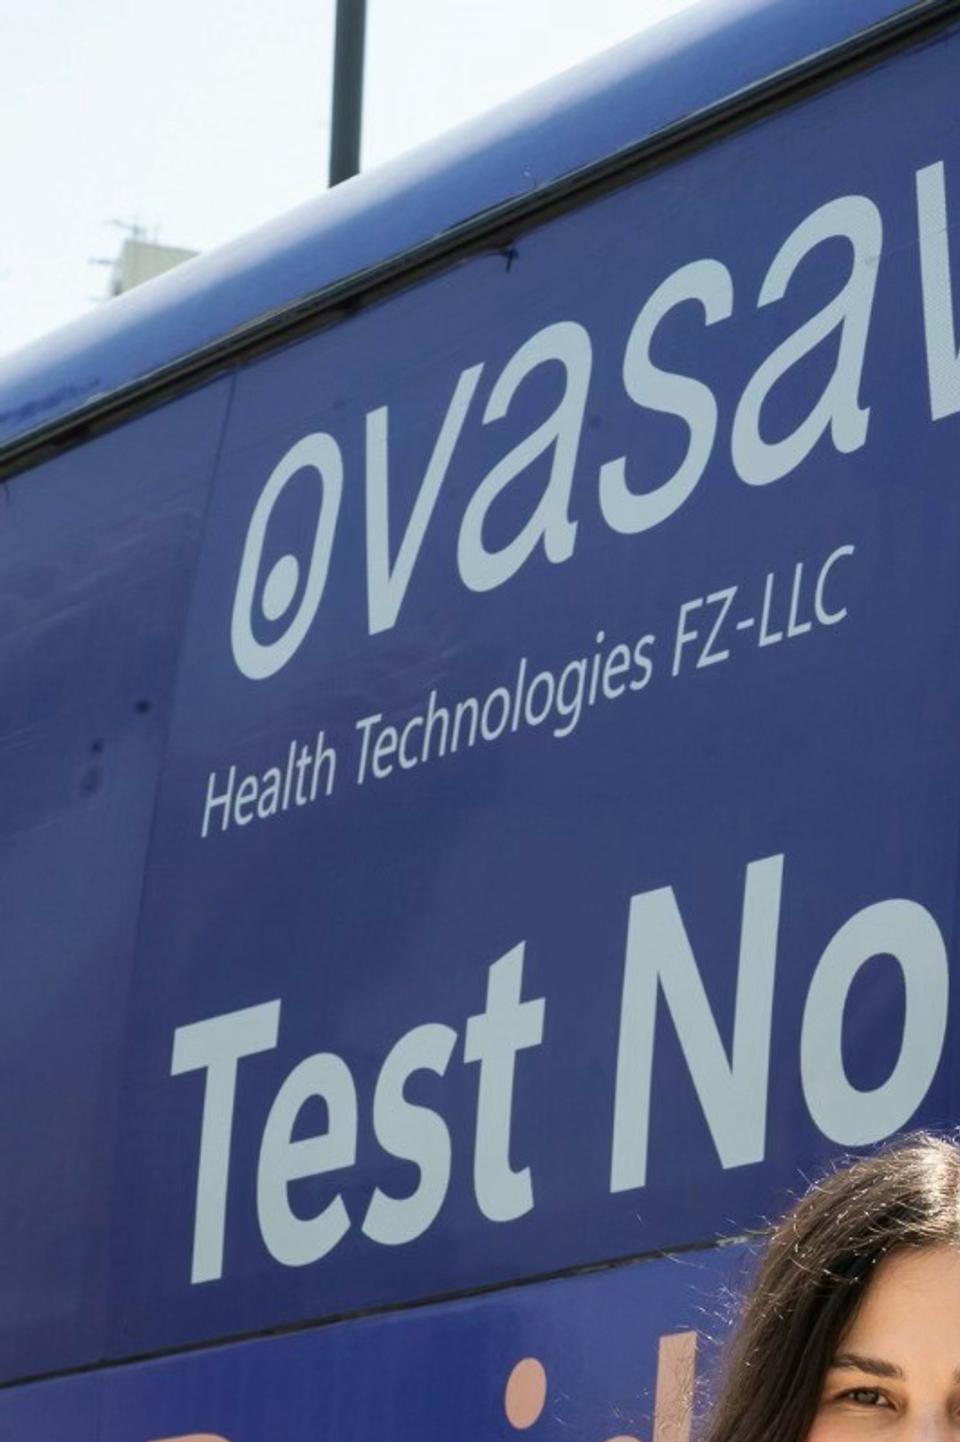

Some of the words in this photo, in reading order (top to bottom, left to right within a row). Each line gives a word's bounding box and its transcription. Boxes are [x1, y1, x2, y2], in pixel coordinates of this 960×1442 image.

[200, 731, 337, 838] Health
[355, 630, 656, 786] Technologies
[671, 544, 855, 677] FZ-LLC
[170, 940, 546, 1285] Test
